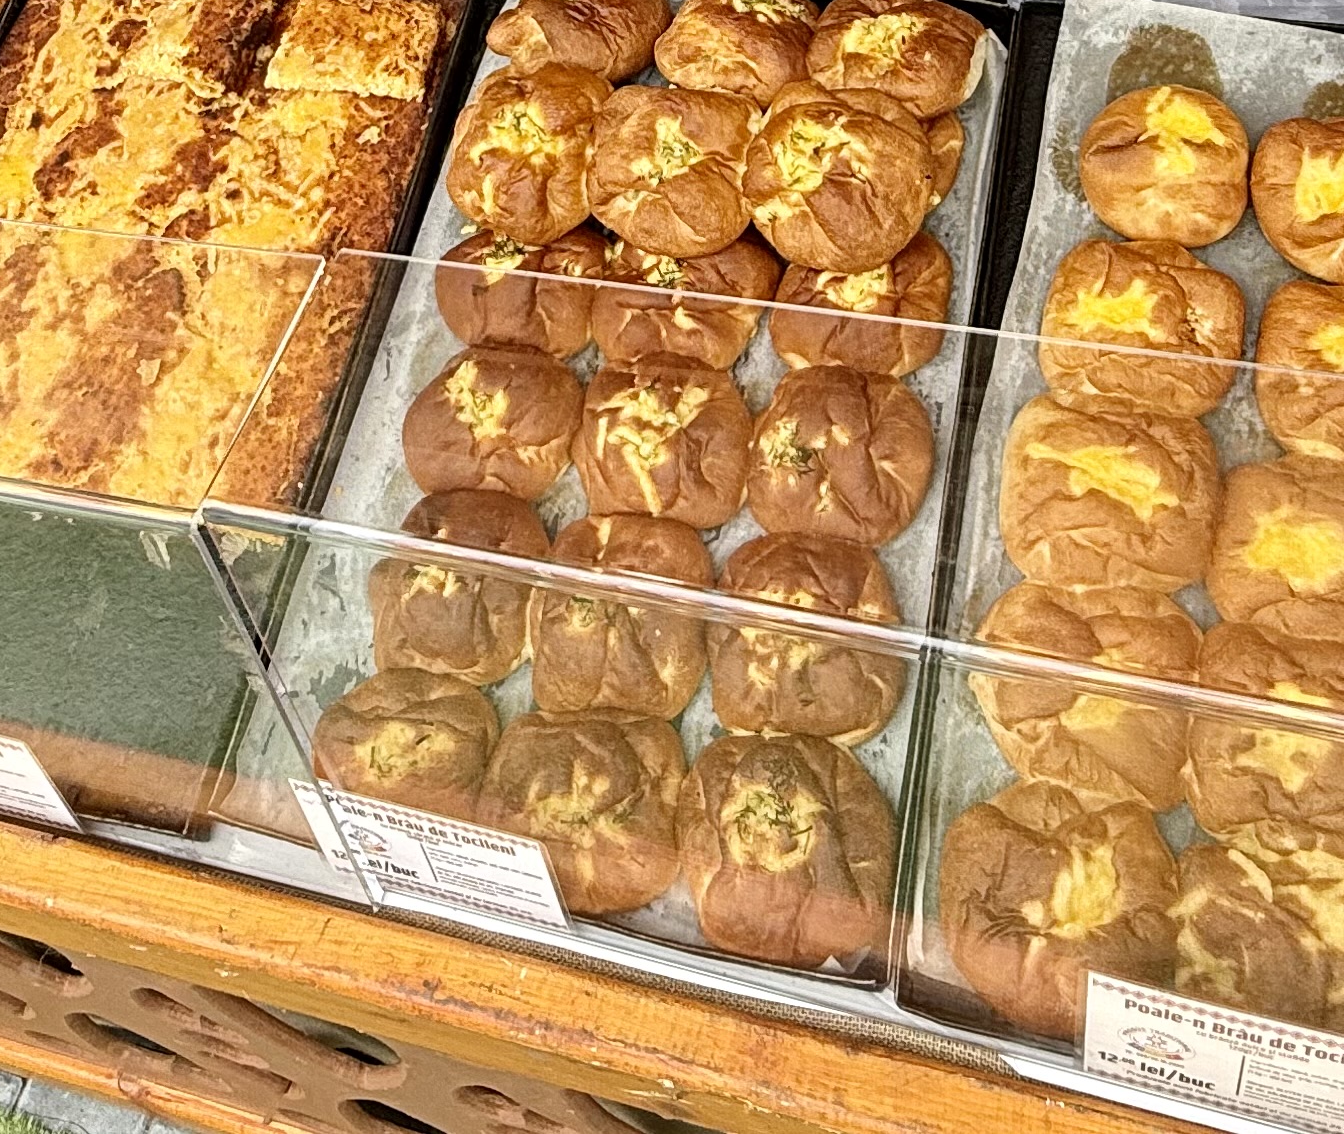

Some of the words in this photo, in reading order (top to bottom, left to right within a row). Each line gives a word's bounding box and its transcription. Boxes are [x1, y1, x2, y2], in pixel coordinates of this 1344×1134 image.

[428, 822, 448, 839] de
[1124, 998, 1205, 1030] Poale-n
[1212, 1022, 1263, 1044] Brâu
[1269, 1038, 1296, 1053] de
[1140, 1061, 1216, 1091] lei/buc
